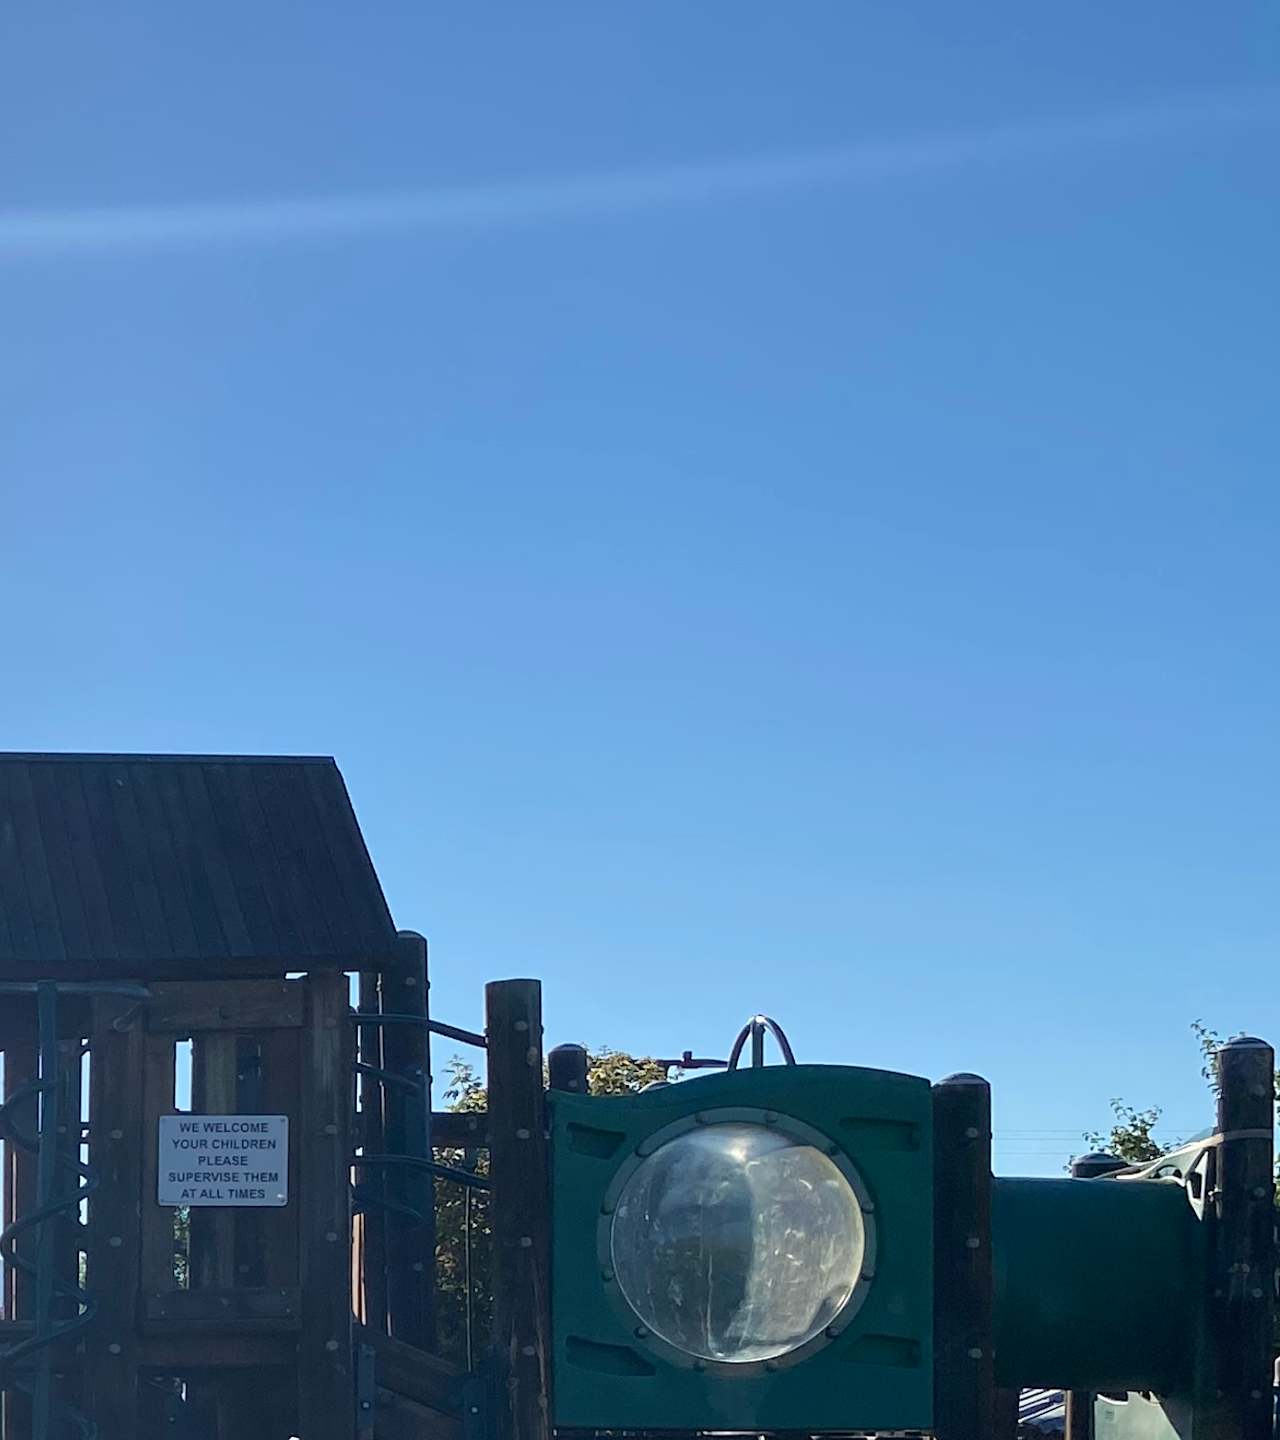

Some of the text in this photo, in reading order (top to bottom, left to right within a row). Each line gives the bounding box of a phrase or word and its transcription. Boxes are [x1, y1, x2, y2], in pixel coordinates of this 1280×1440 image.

[180, 1123, 269, 1133] WE WELCOME
[172, 1140, 276, 1149] YOUR CHILDREN
[198, 1156, 248, 1166] PLEASE
[168, 1172, 279, 1182] SUPERVISE THEM
[181, 1189, 266, 1199] AT ALL TIMES
